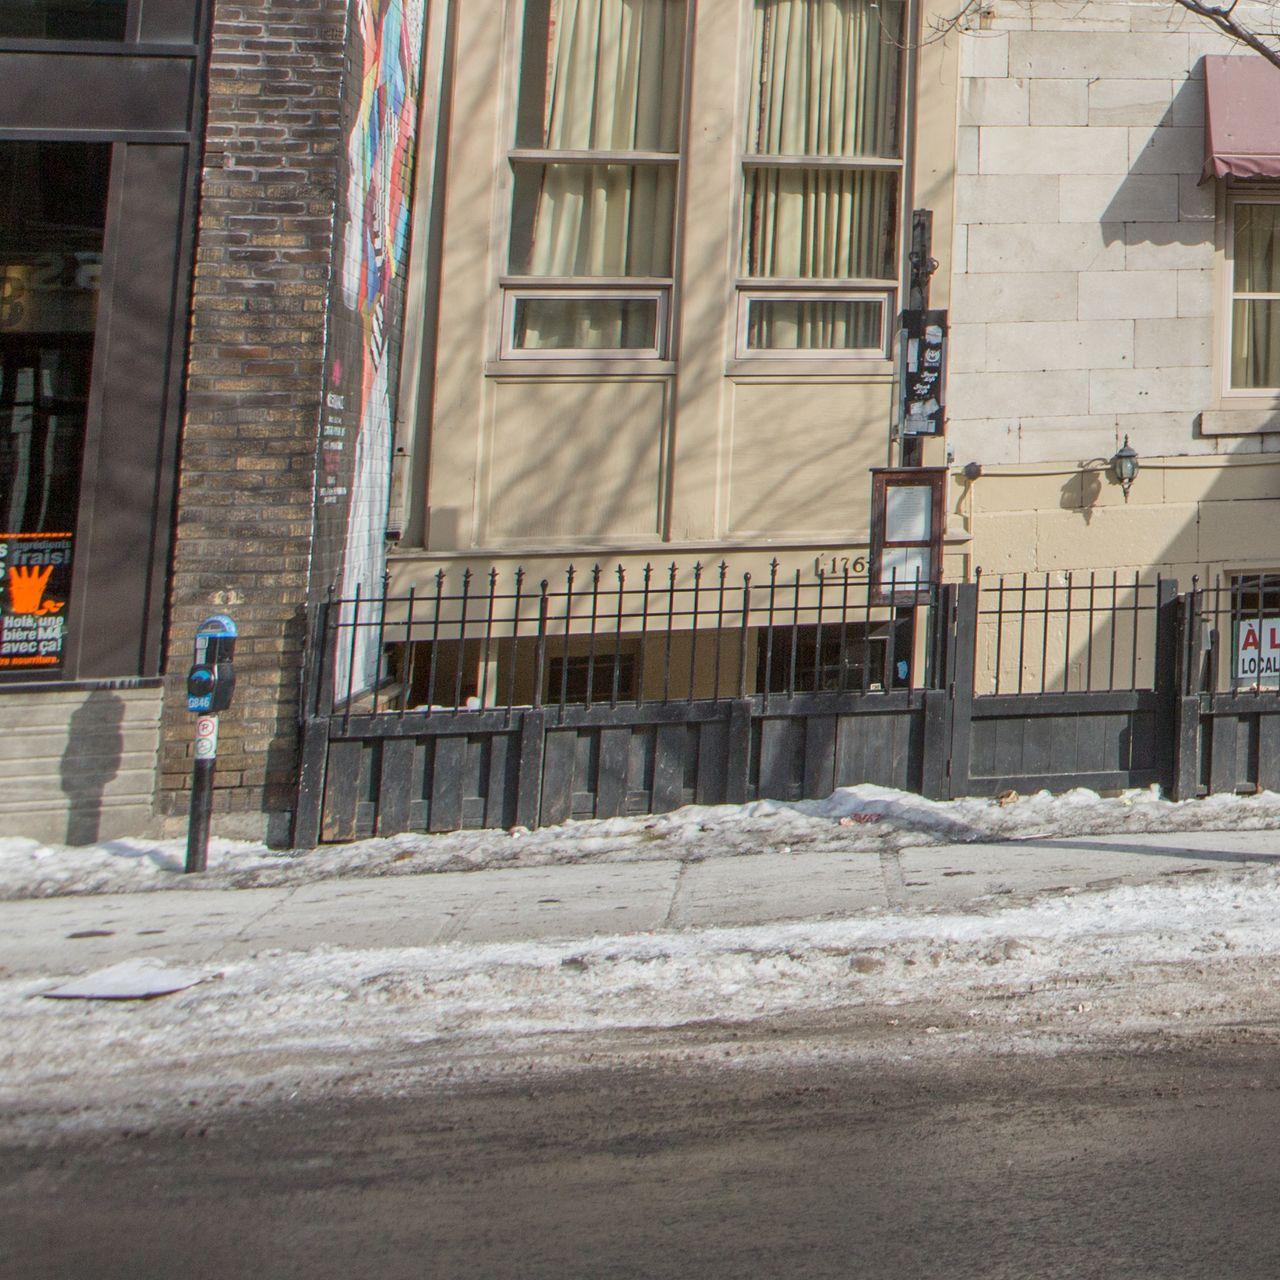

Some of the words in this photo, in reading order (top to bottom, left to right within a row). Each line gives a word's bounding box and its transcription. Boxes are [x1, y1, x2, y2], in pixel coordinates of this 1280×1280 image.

[12, 549, 71, 566] frais!
[830, 556, 870, 575] 176
[4, 615, 37, 629] Holà,
[38, 615, 64, 626] une
[2, 628, 36, 641] bière
[1242, 623, 1259, 650] À
[1, 641, 37, 654] avec
[39, 638, 62, 656] ça!
[1241, 656, 1279, 675] LOCAL
